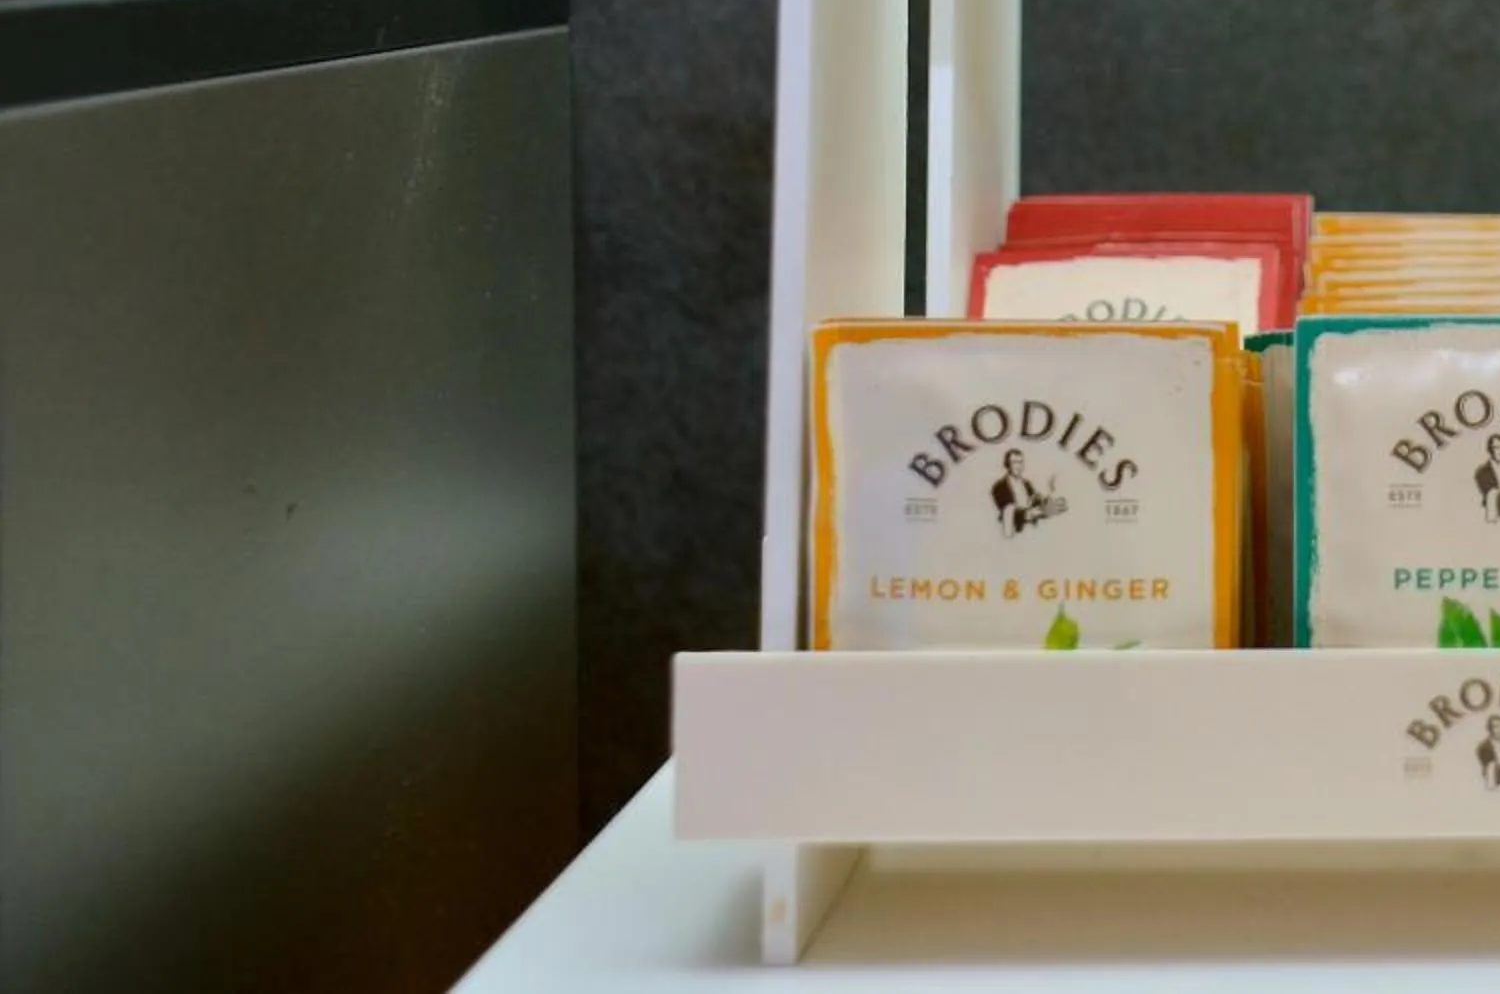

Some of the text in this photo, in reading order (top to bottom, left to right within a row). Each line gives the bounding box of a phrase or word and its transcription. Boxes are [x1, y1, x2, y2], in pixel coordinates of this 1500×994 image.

[908, 400, 1139, 493] BRODIES
[871, 576, 1170, 600] LEMON & GINGER
